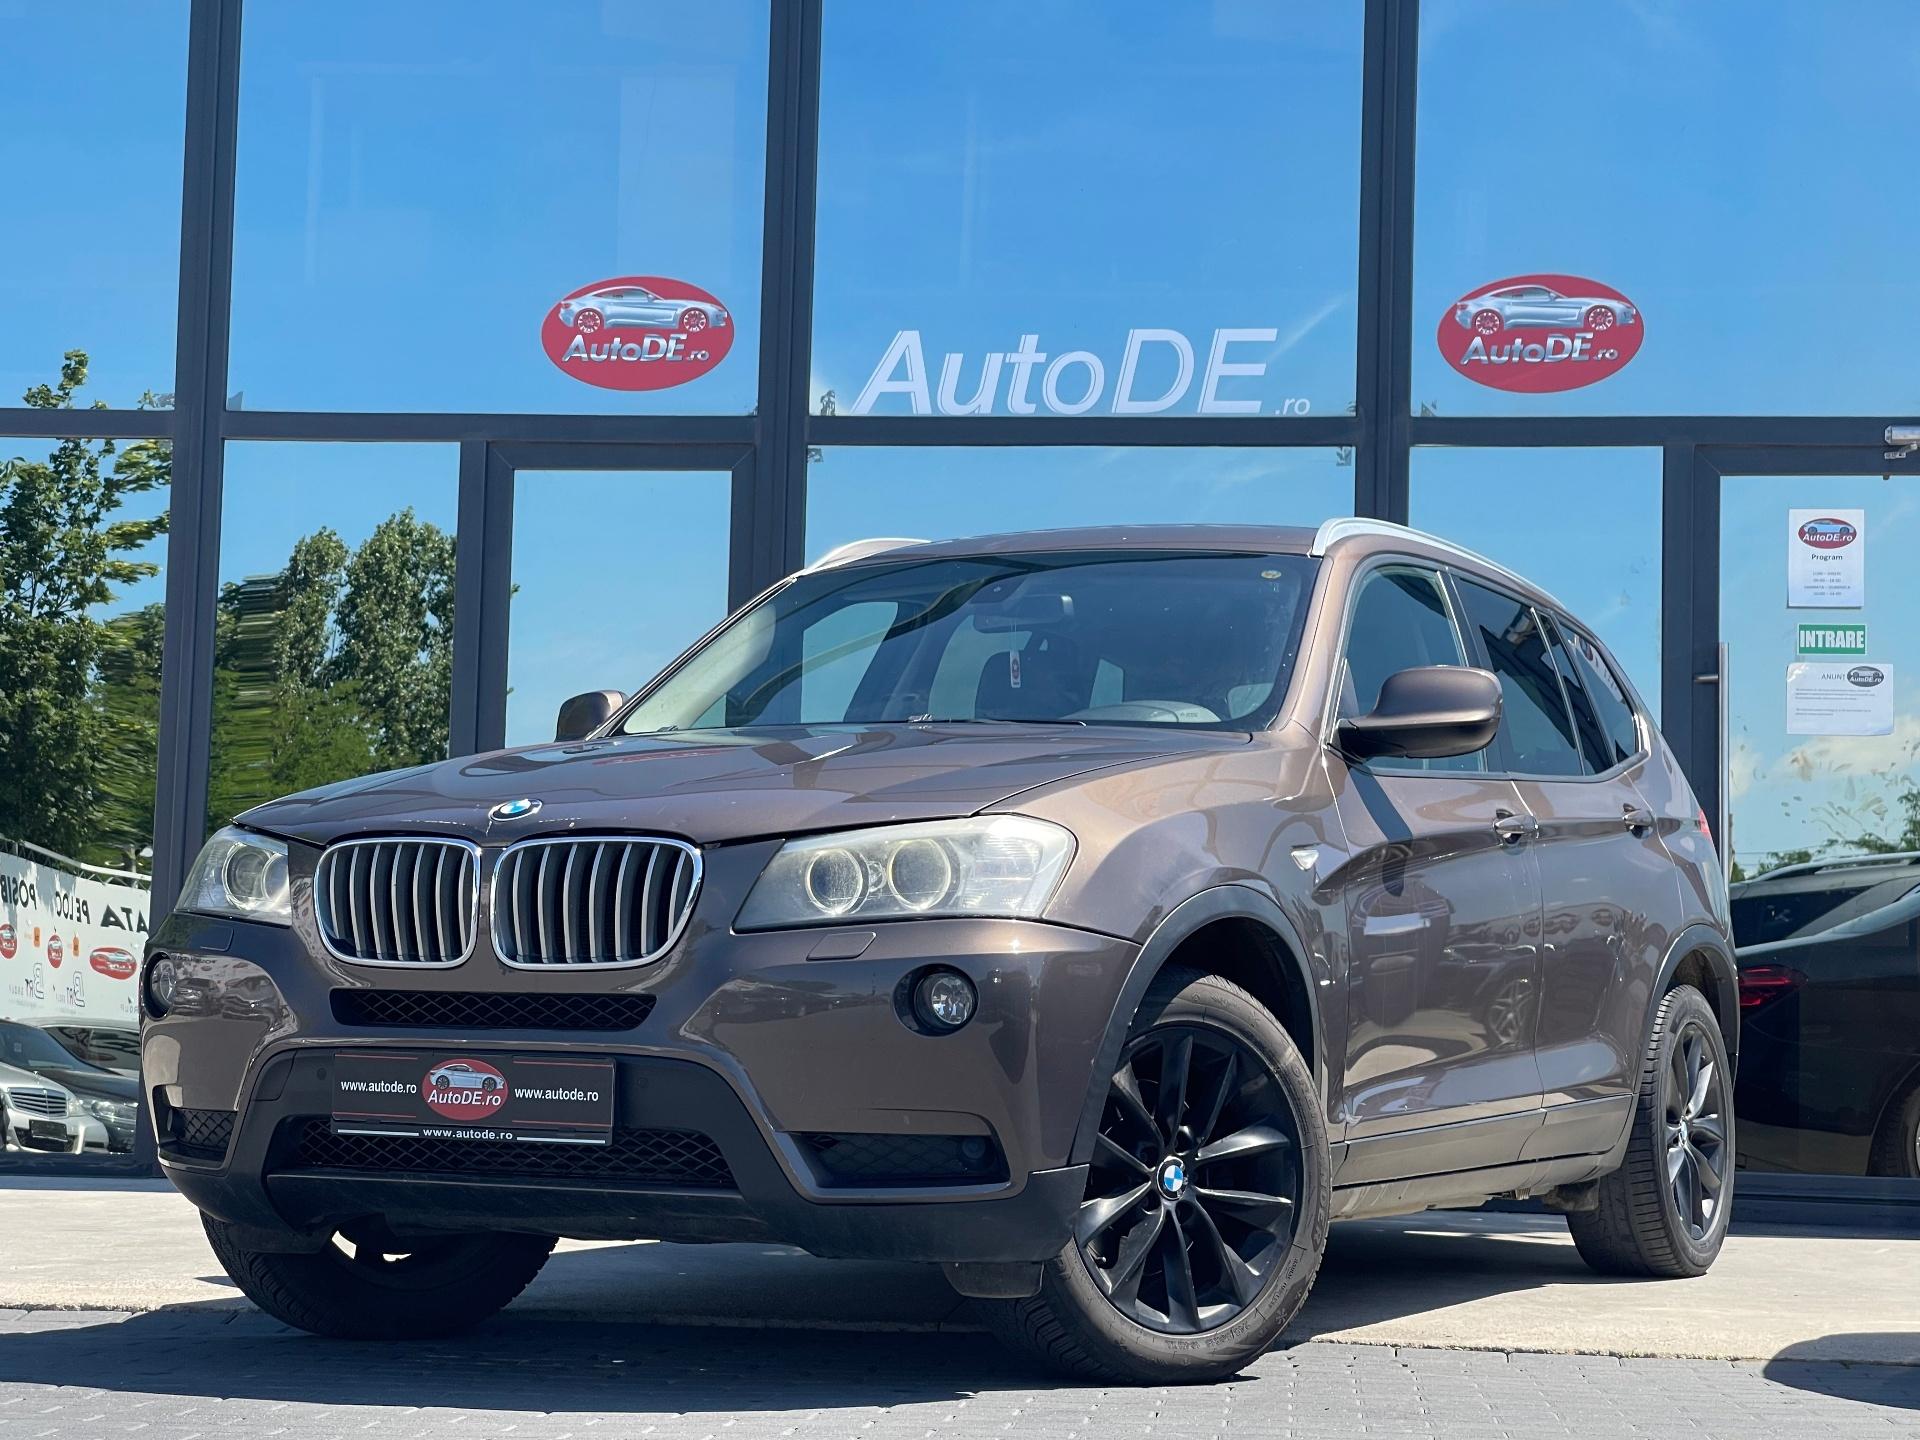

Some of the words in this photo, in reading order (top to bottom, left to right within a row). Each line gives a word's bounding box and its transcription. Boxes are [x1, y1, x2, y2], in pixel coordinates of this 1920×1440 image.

[1802, 533, 1853, 542] AutoDE.ro
[1811, 554, 1843, 562] Program
[1800, 630, 1865, 648] INTRARE
[341, 1080, 417, 1094] www.autode.ro
[428, 1089, 501, 1106] AutoDE.ro
[514, 1087, 599, 1102] www.autode.ro
[423, 1128, 513, 1140] www.autode.ro
